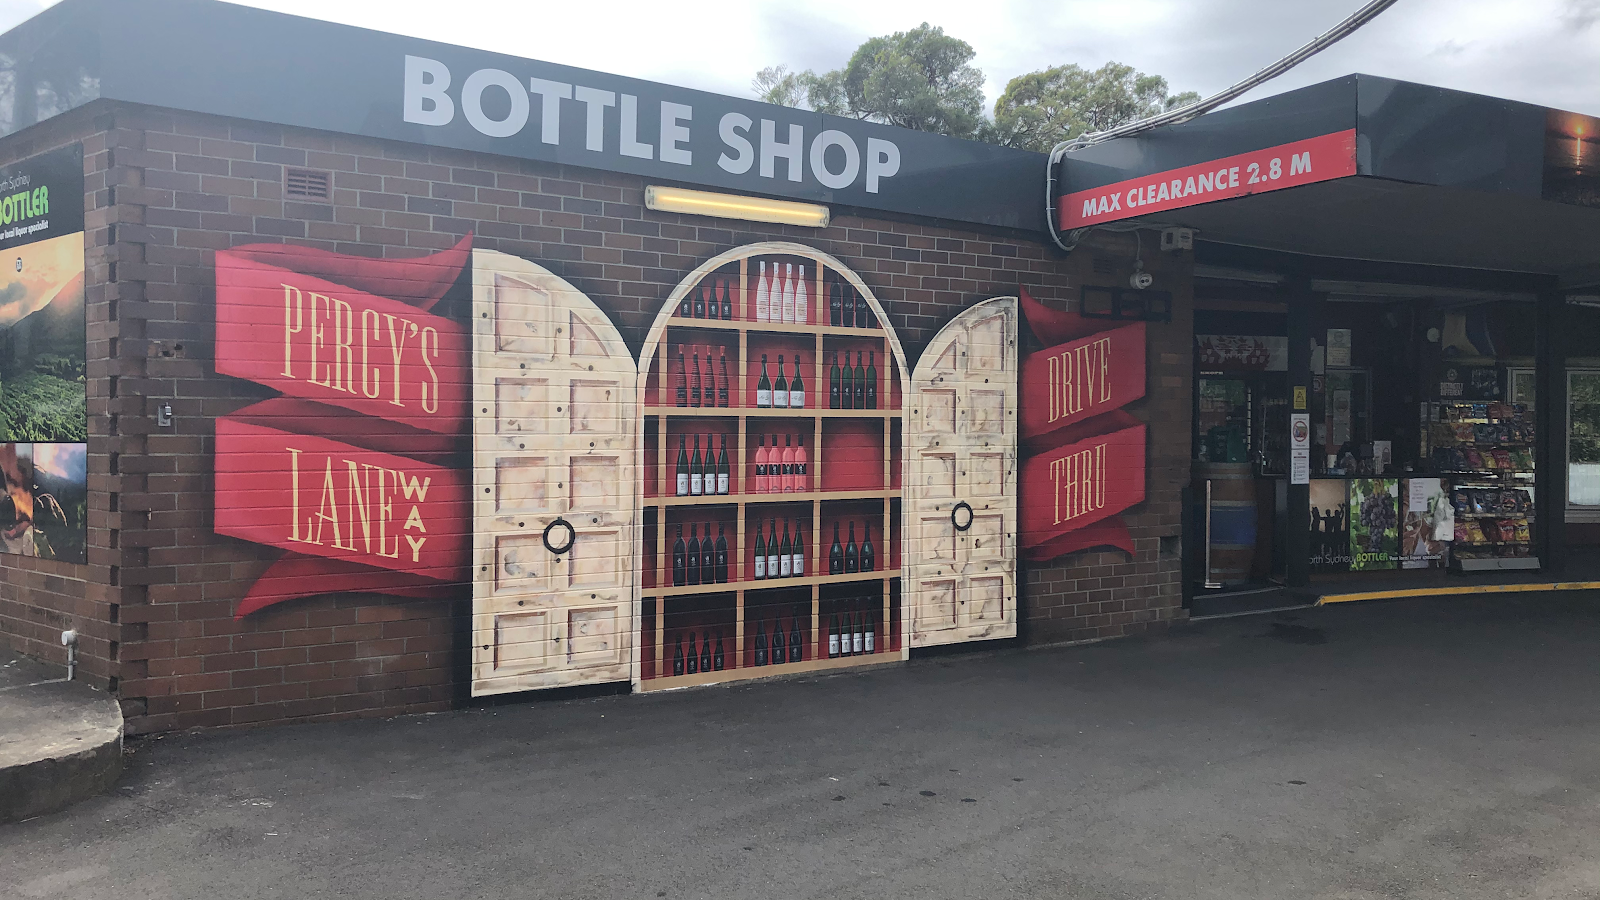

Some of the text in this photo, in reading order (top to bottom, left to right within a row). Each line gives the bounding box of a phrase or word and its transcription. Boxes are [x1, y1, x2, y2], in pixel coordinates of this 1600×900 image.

[403, 54, 901, 195] BOTTLE SHOP
[9, 171, 31, 191] Sydney
[1081, 151, 1312, 218] MAX CLEARANCE 2.8 M
[280, 282, 439, 414] PERCY'S
[1047, 336, 1111, 424] DRIVE
[1049, 442, 1107, 526] THRU
[1325, 553, 1355, 566] Sydney
[1356, 552, 1388, 562] BOTTLER
